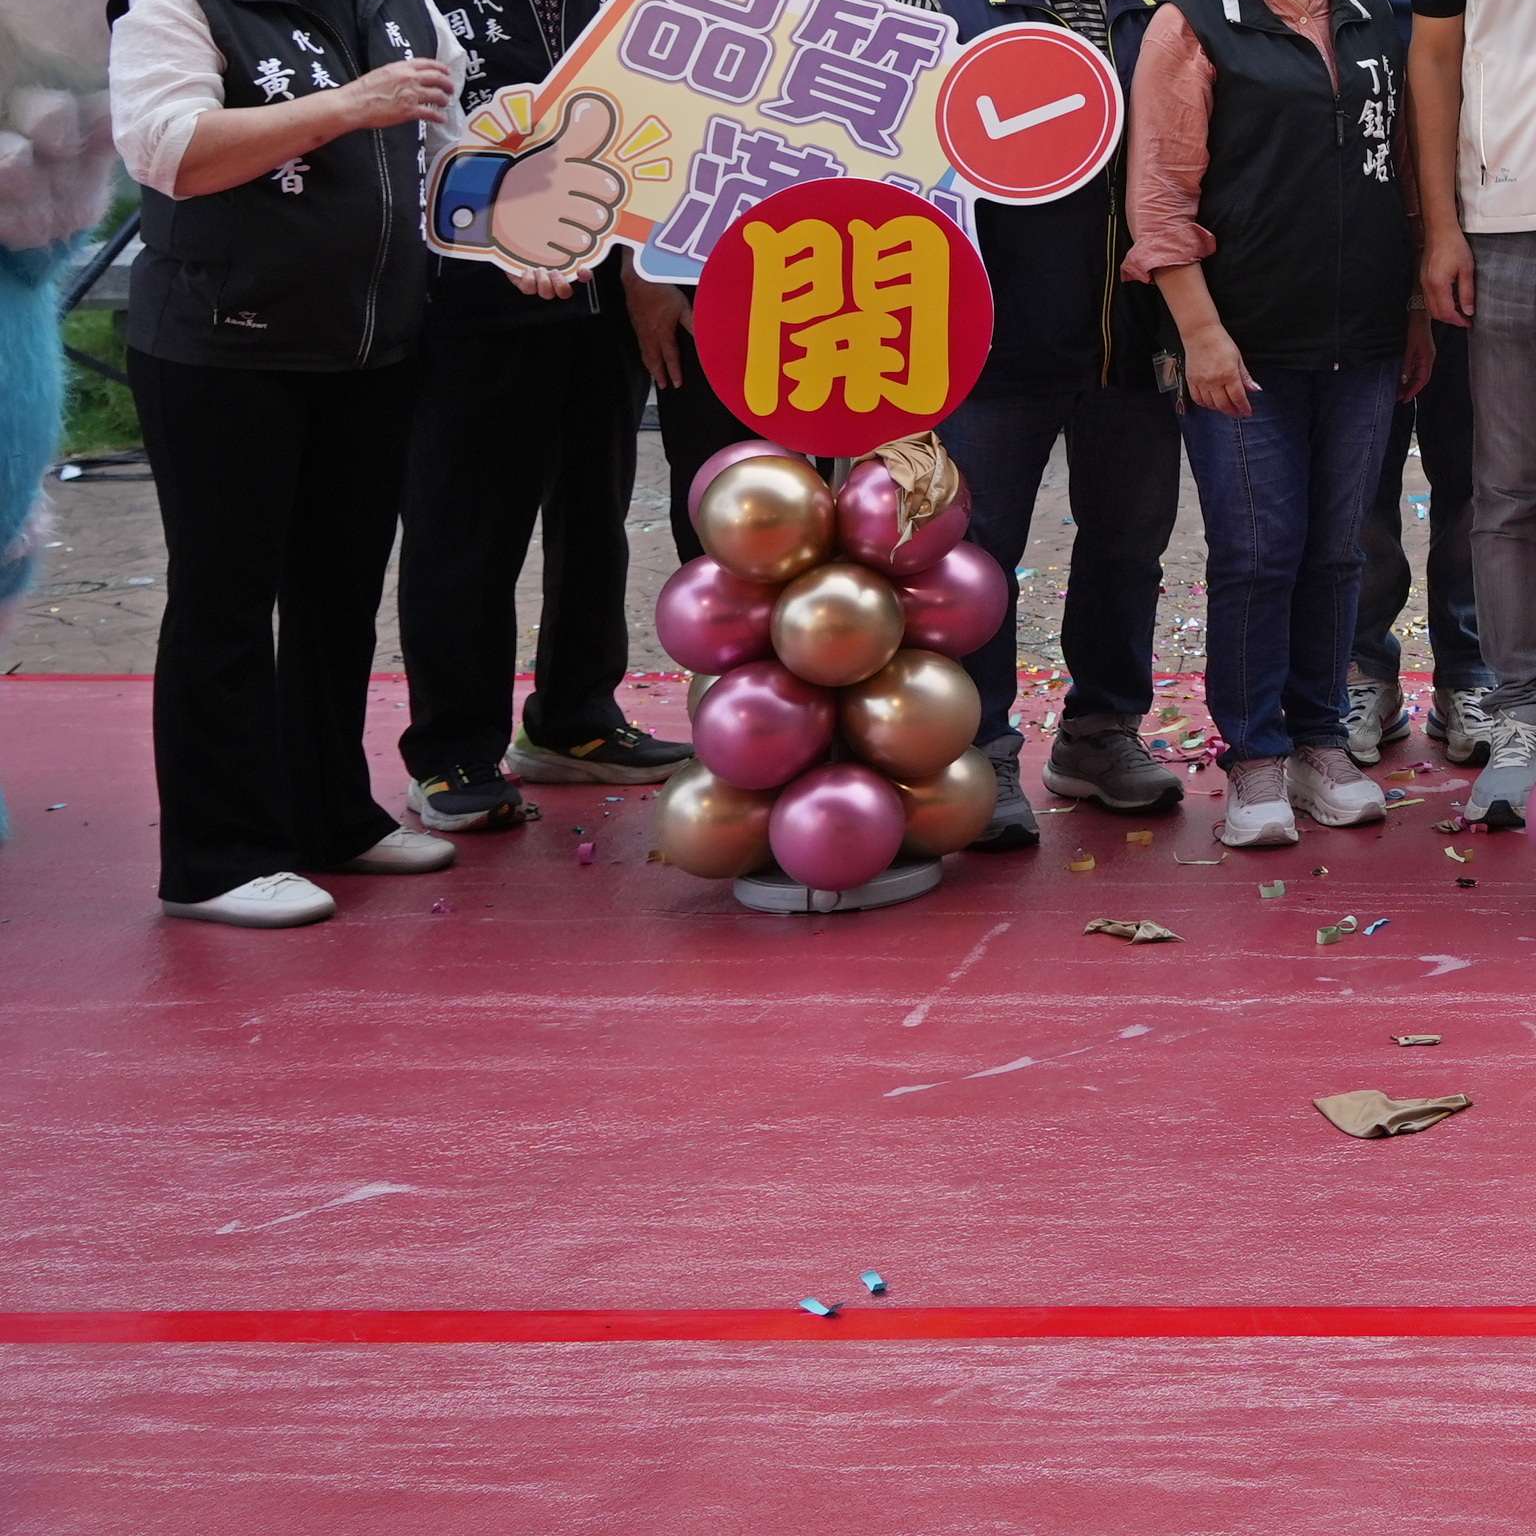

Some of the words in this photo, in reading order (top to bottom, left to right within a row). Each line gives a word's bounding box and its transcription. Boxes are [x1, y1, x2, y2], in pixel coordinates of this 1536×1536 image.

[253, 58, 311, 196] 黃香
[292, 29, 341, 90] 代表
[742, 214, 952, 416] 開
